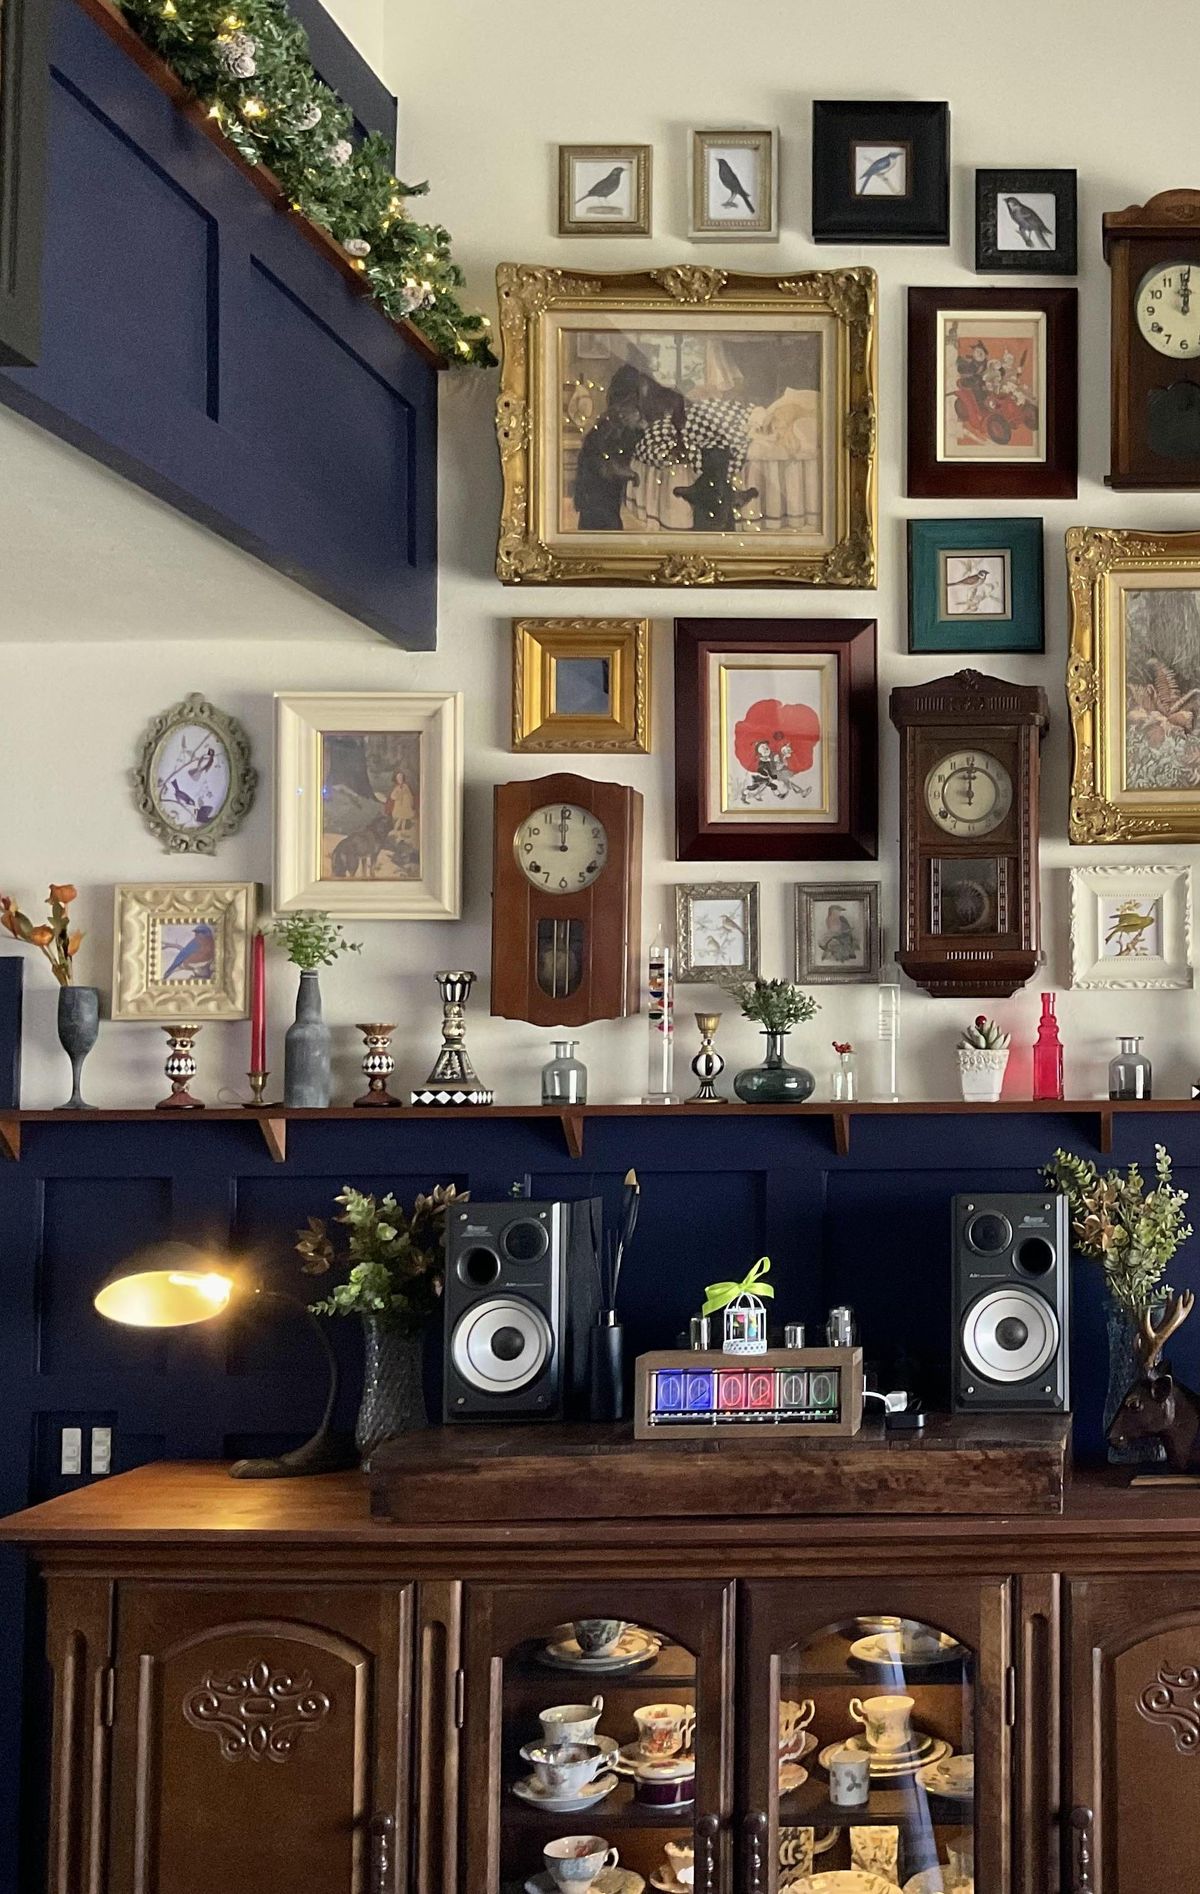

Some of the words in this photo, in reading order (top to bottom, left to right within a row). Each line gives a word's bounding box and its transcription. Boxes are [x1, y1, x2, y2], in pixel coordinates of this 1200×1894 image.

[1163, 277, 1172, 288] 11
[1150, 289, 1162, 299] 10
[1146, 306, 1155, 316] 9
[1151, 322, 1160, 332] 8
[1164, 334, 1172, 344] 7
[1180, 339, 1189, 350] 6
[545, 812, 552, 824] 11
[582, 815, 586, 825] 1
[528, 827, 540, 838] 10
[591, 828, 600, 839] 2
[524, 843, 533, 855] 9
[596, 844, 605, 855] 3
[542, 872, 550, 883] 7
[559, 877, 568, 889] 6
[577, 872, 586, 883] 5
